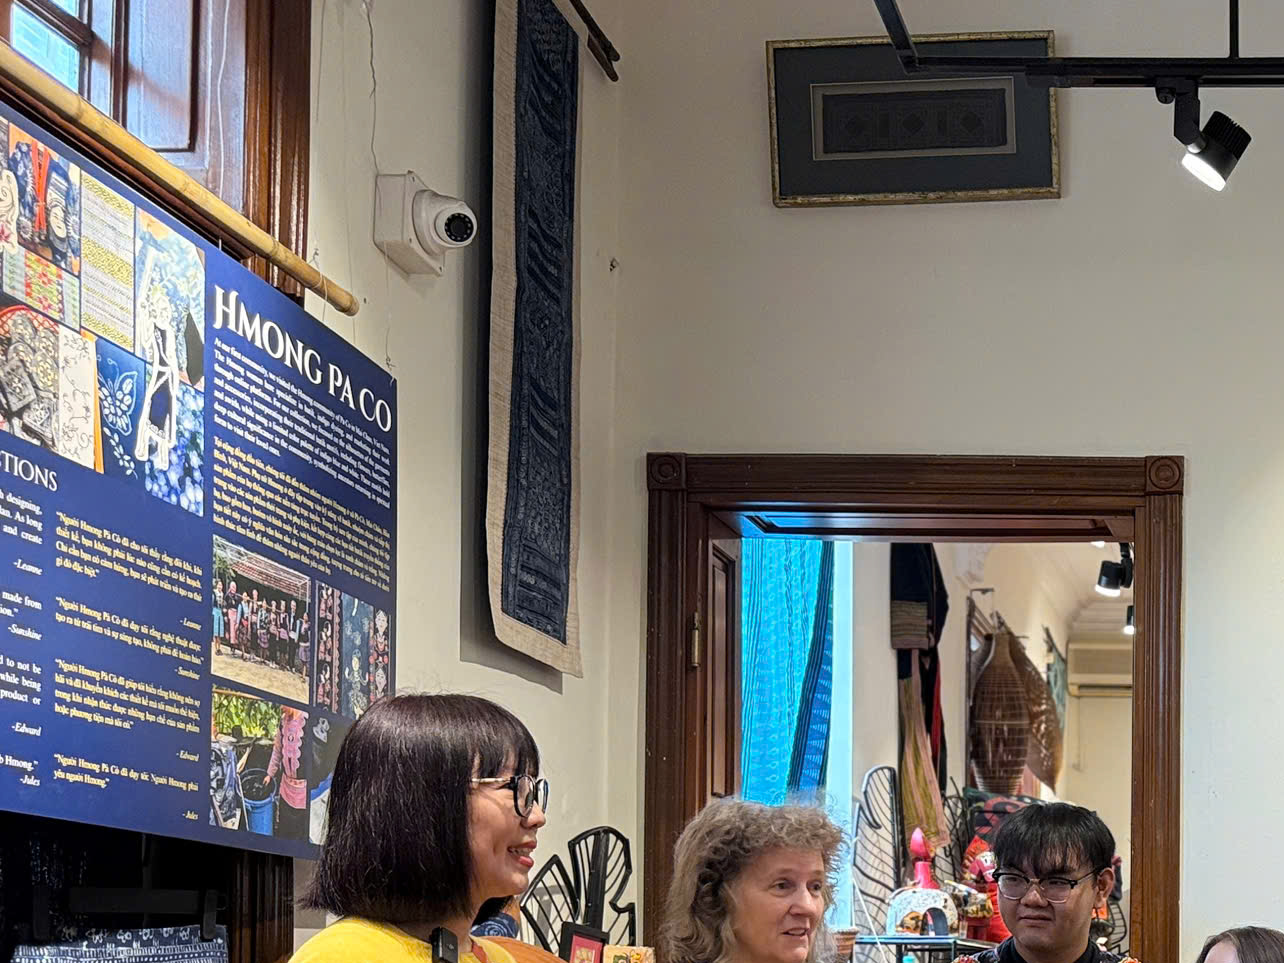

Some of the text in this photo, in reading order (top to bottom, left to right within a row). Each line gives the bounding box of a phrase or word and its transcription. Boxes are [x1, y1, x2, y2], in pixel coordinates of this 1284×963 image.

[212, 284, 392, 432] HMONG PA CO
[0, 450, 58, 492] TIONS
[14, 511, 25, 522] As
[26, 514, 42, 531] long
[2, 524, 43, 544] and create
[2, 591, 42, 610] made from
[6, 658, 14, 667] to
[16, 662, 30, 672] not
[32, 663, 42, 674] be
[22, 676, 42, 692] being
[0, 689, 42, 705] product or
